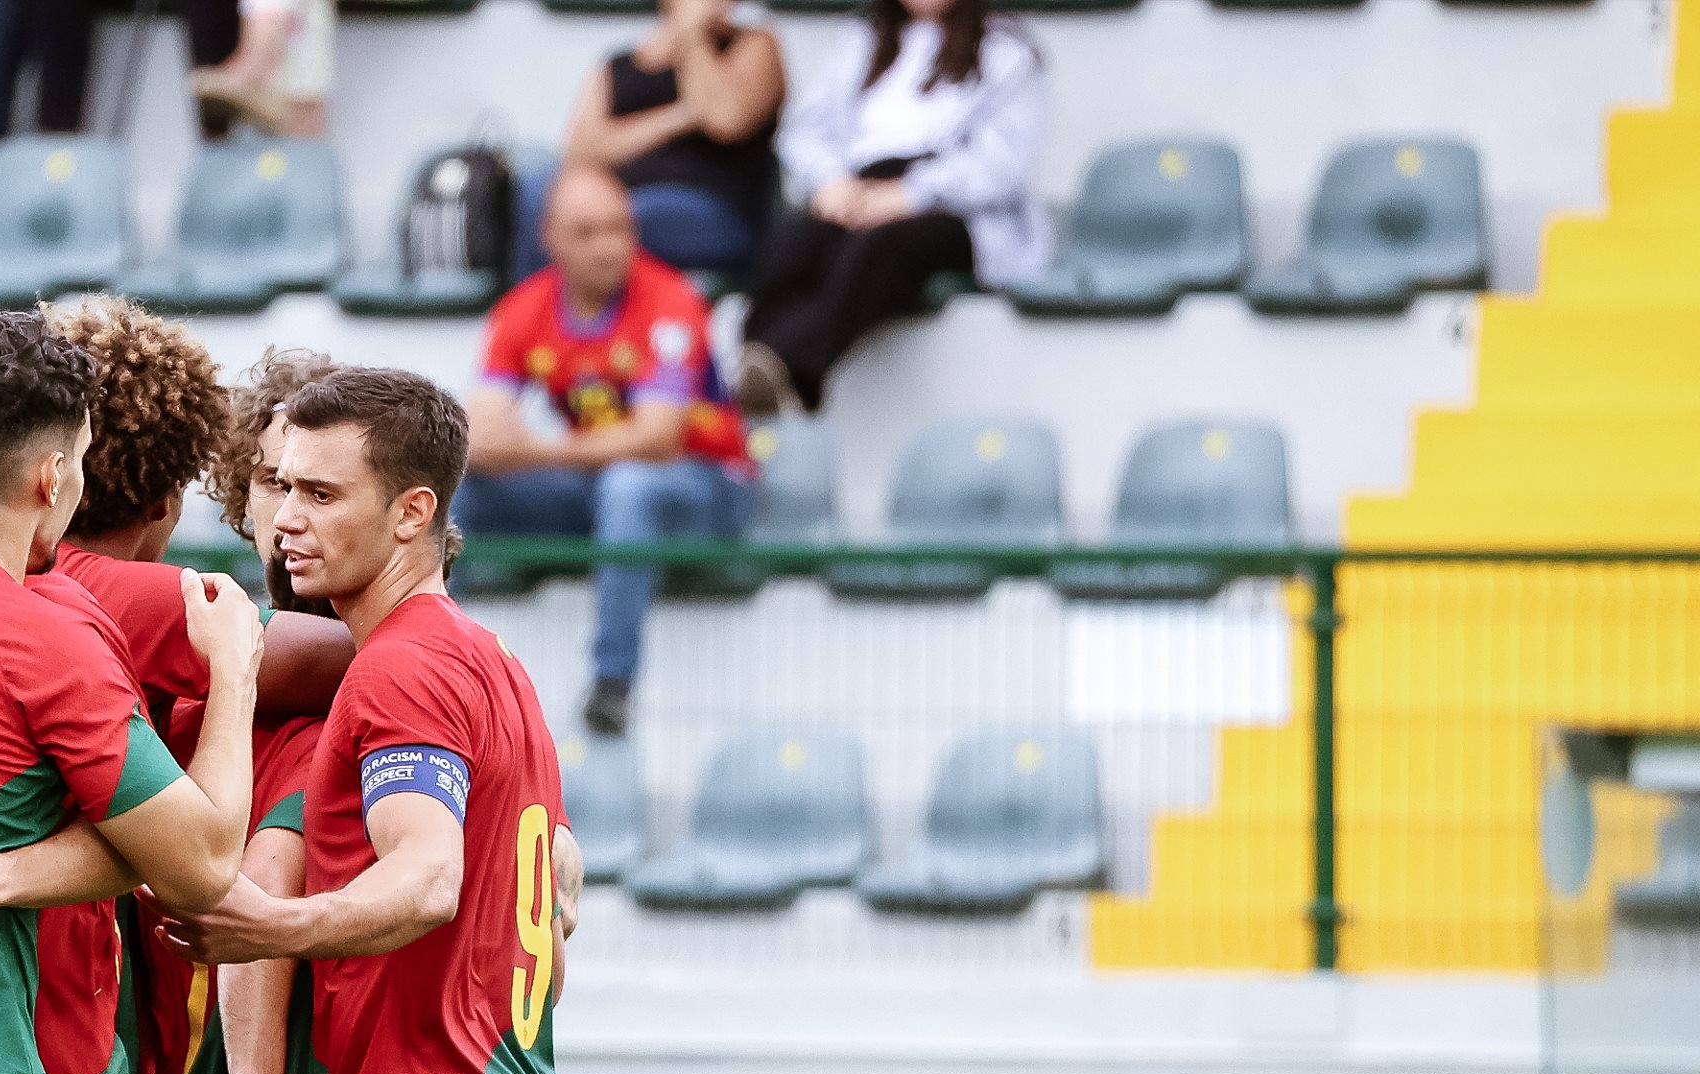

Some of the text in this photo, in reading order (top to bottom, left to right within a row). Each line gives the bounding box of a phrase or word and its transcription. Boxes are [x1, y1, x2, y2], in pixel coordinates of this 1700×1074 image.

[371, 752, 423, 769] RACISM
[429, 754, 451, 769] NO
[511, 803, 553, 1050] 9
